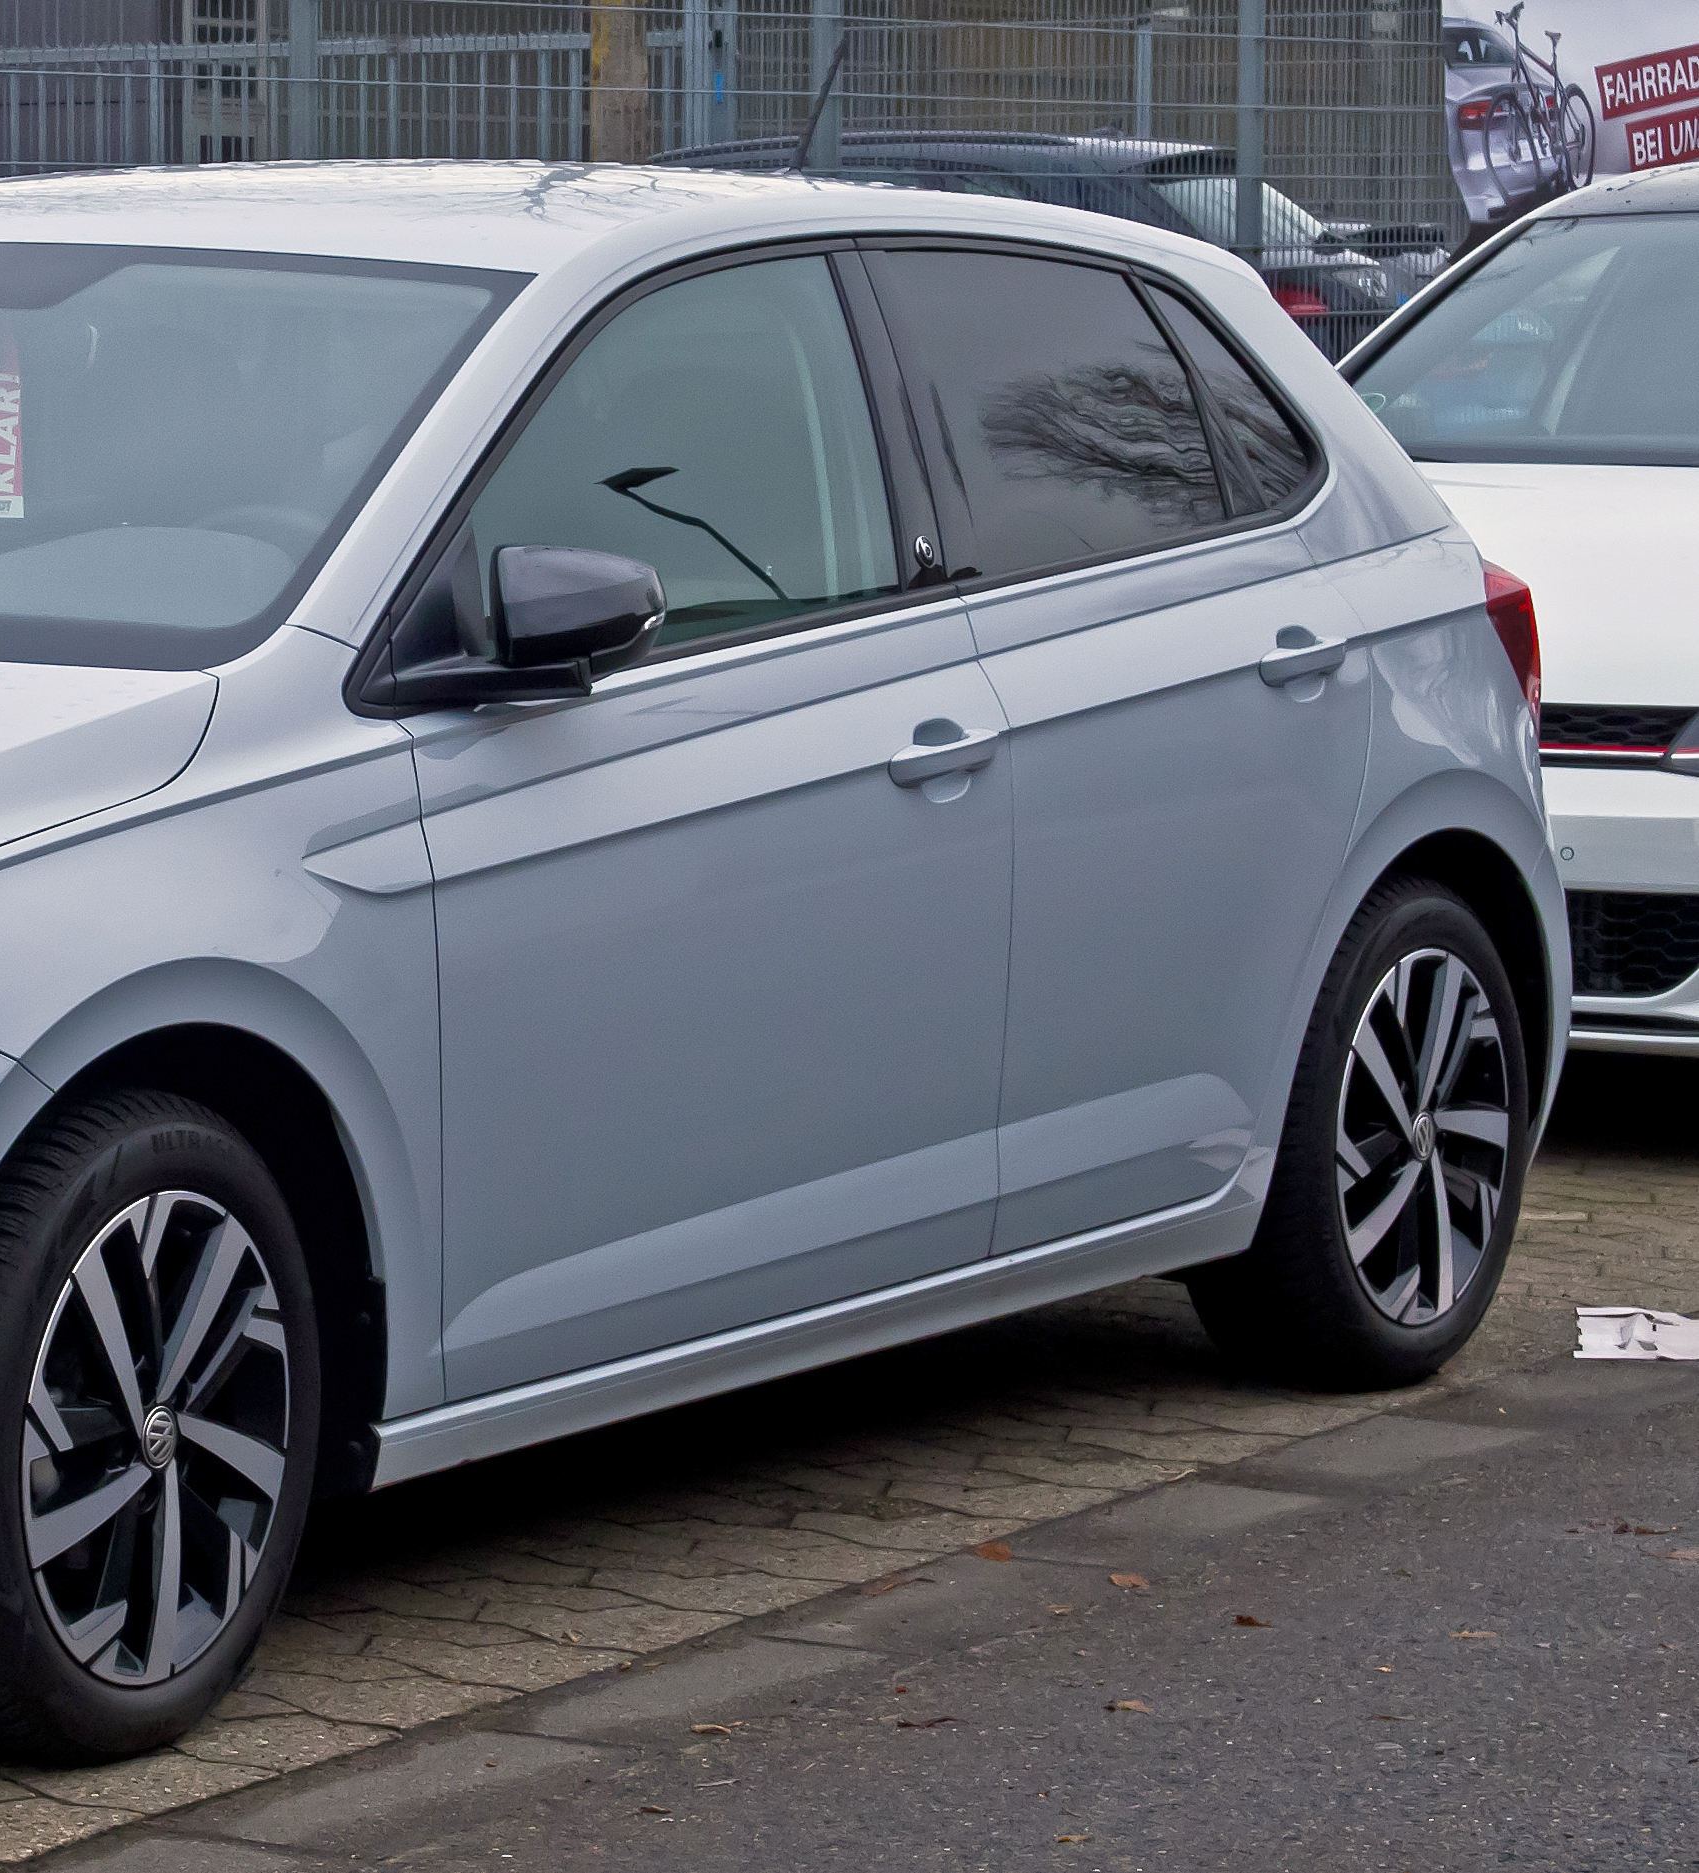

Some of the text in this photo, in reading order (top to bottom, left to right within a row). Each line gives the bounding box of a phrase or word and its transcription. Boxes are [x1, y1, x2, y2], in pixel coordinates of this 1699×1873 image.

[1602, 55, 1699, 109] FAHRRAD
[1632, 117, 1699, 166] BEI UN
